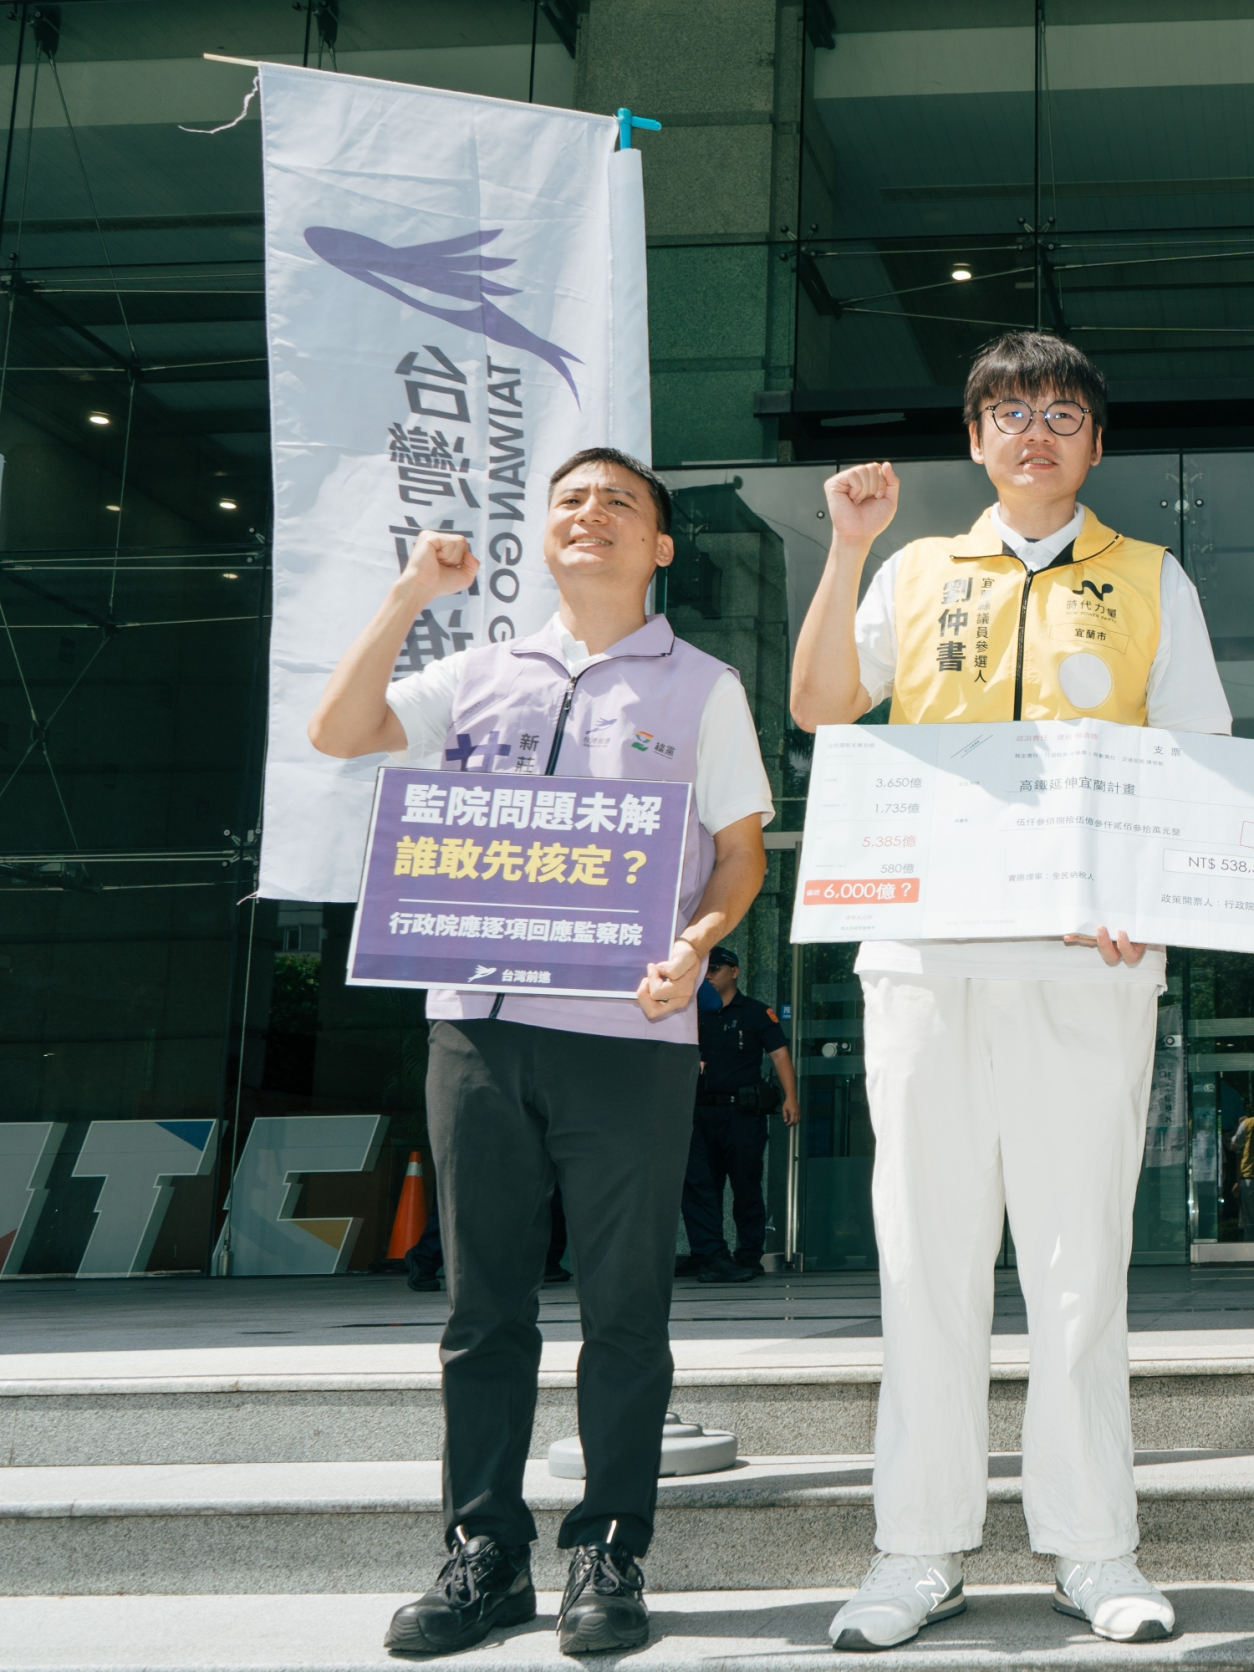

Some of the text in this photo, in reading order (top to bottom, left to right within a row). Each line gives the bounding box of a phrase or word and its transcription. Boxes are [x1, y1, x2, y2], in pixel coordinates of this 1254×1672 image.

[936, 576, 974, 672] 劉仲書
[1074, 628, 1107, 641] 宜蘭市
[515, 733, 540, 773] 新莊
[654, 741, 676, 758] 綠黨
[875, 776, 923, 790] 3,650億
[1019, 776, 1136, 796] 高鐵延伸宜蘭計畫
[401, 784, 663, 836] 監院問題未解
[874, 802, 920, 815] 1,735億
[861, 834, 918, 849] 5,385億
[393, 835, 647, 886] 誰敢先核定？
[879, 862, 916, 875] 580億
[1188, 856, 1217, 871] NT$
[823, 882, 913, 901] 6,000億？
[389, 912, 644, 946] 行政院應逐項回應監察院
[501, 969, 551, 985] 台灣前進
